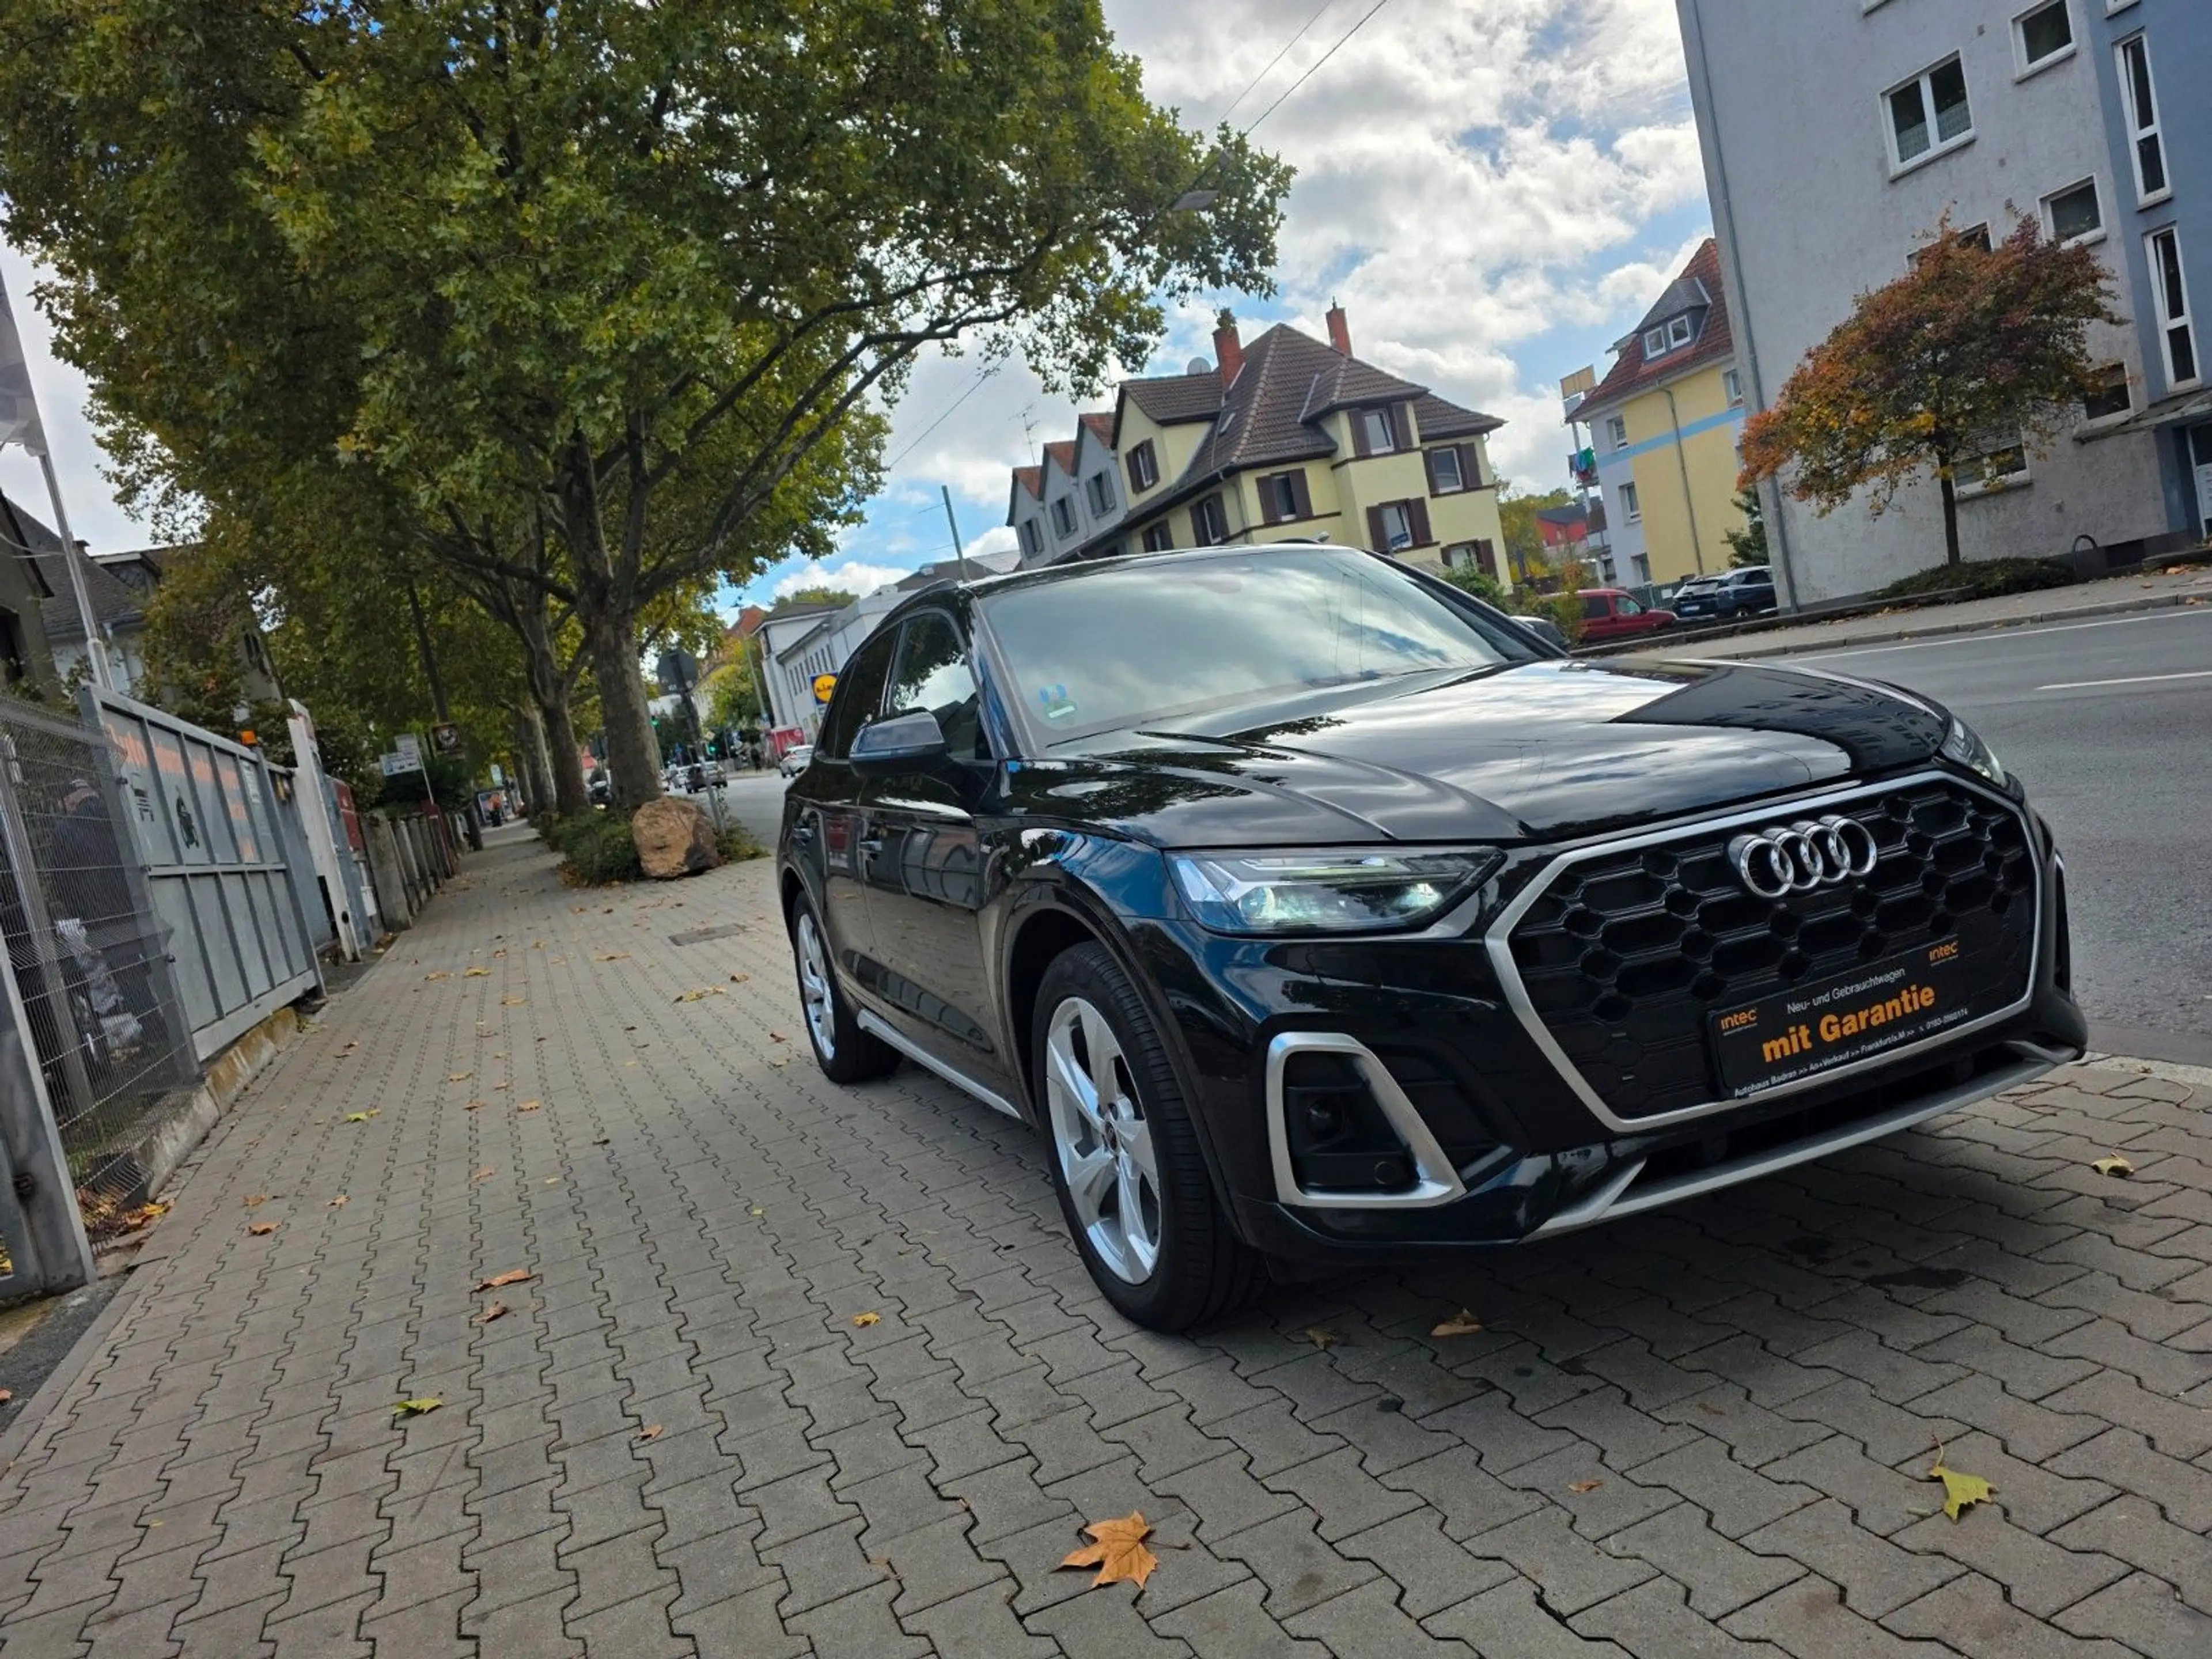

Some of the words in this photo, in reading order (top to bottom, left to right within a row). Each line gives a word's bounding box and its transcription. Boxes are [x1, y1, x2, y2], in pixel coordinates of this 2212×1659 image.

[1787, 1002, 1810, 1014] Neu-
[1812, 991, 1830, 1006] und
[1832, 968, 1906, 999] Gebrauchtwagen
[1763, 1025, 1812, 1063] mit
[1820, 984, 1935, 1042] Garantie
[1735, 1080, 1770, 1097] Autohaus
